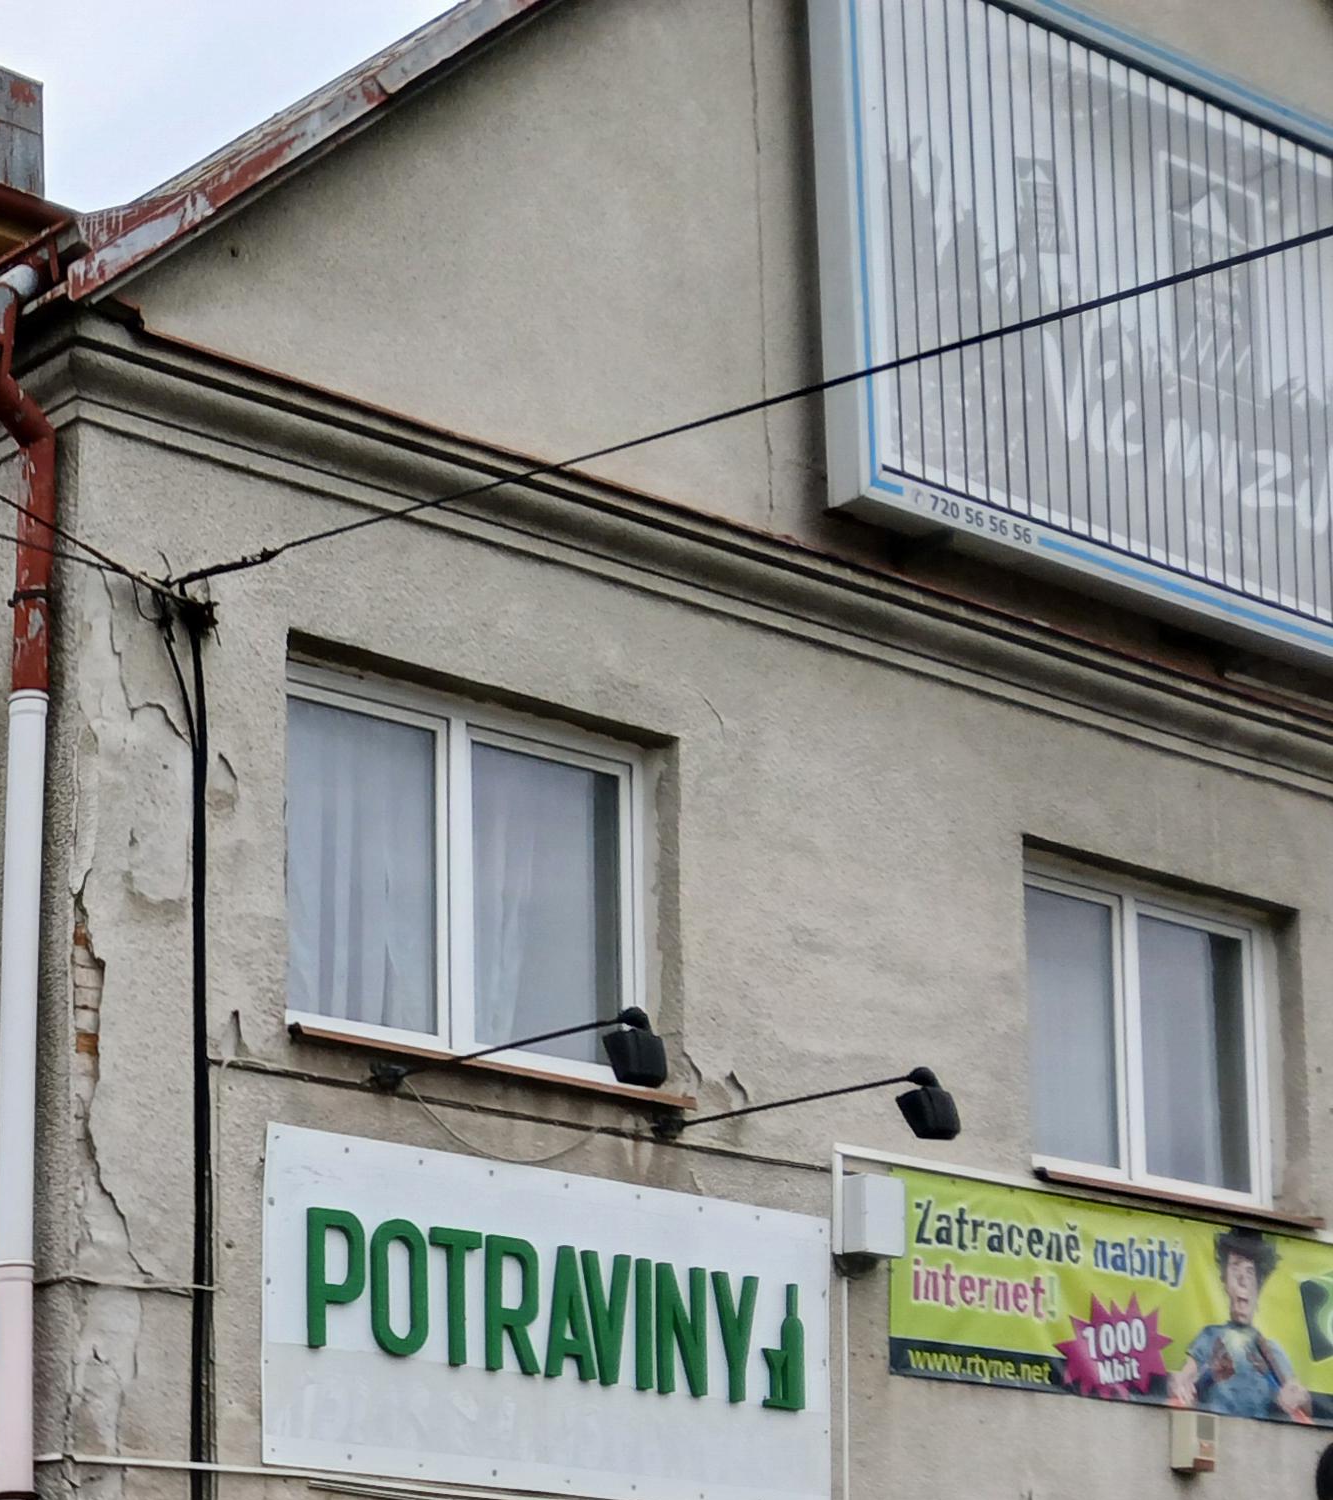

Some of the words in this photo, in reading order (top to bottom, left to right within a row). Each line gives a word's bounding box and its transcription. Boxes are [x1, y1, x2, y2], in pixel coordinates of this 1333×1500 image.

[929, 494, 960, 519] 720
[964, 506, 985, 528] 56
[989, 515, 1009, 536] 56
[1012, 523, 1033, 544] 56
[914, 1199, 1082, 1265] Zatraceně
[1093, 1236, 1186, 1288] nabitý
[306, 1206, 759, 1404] POTRAVINY
[912, 1258, 1057, 1319] internet!
[1081, 1317, 1148, 1360] 1000
[907, 1348, 1053, 1385] www.rtyne.net
[1097, 1356, 1141, 1385] Mbit
